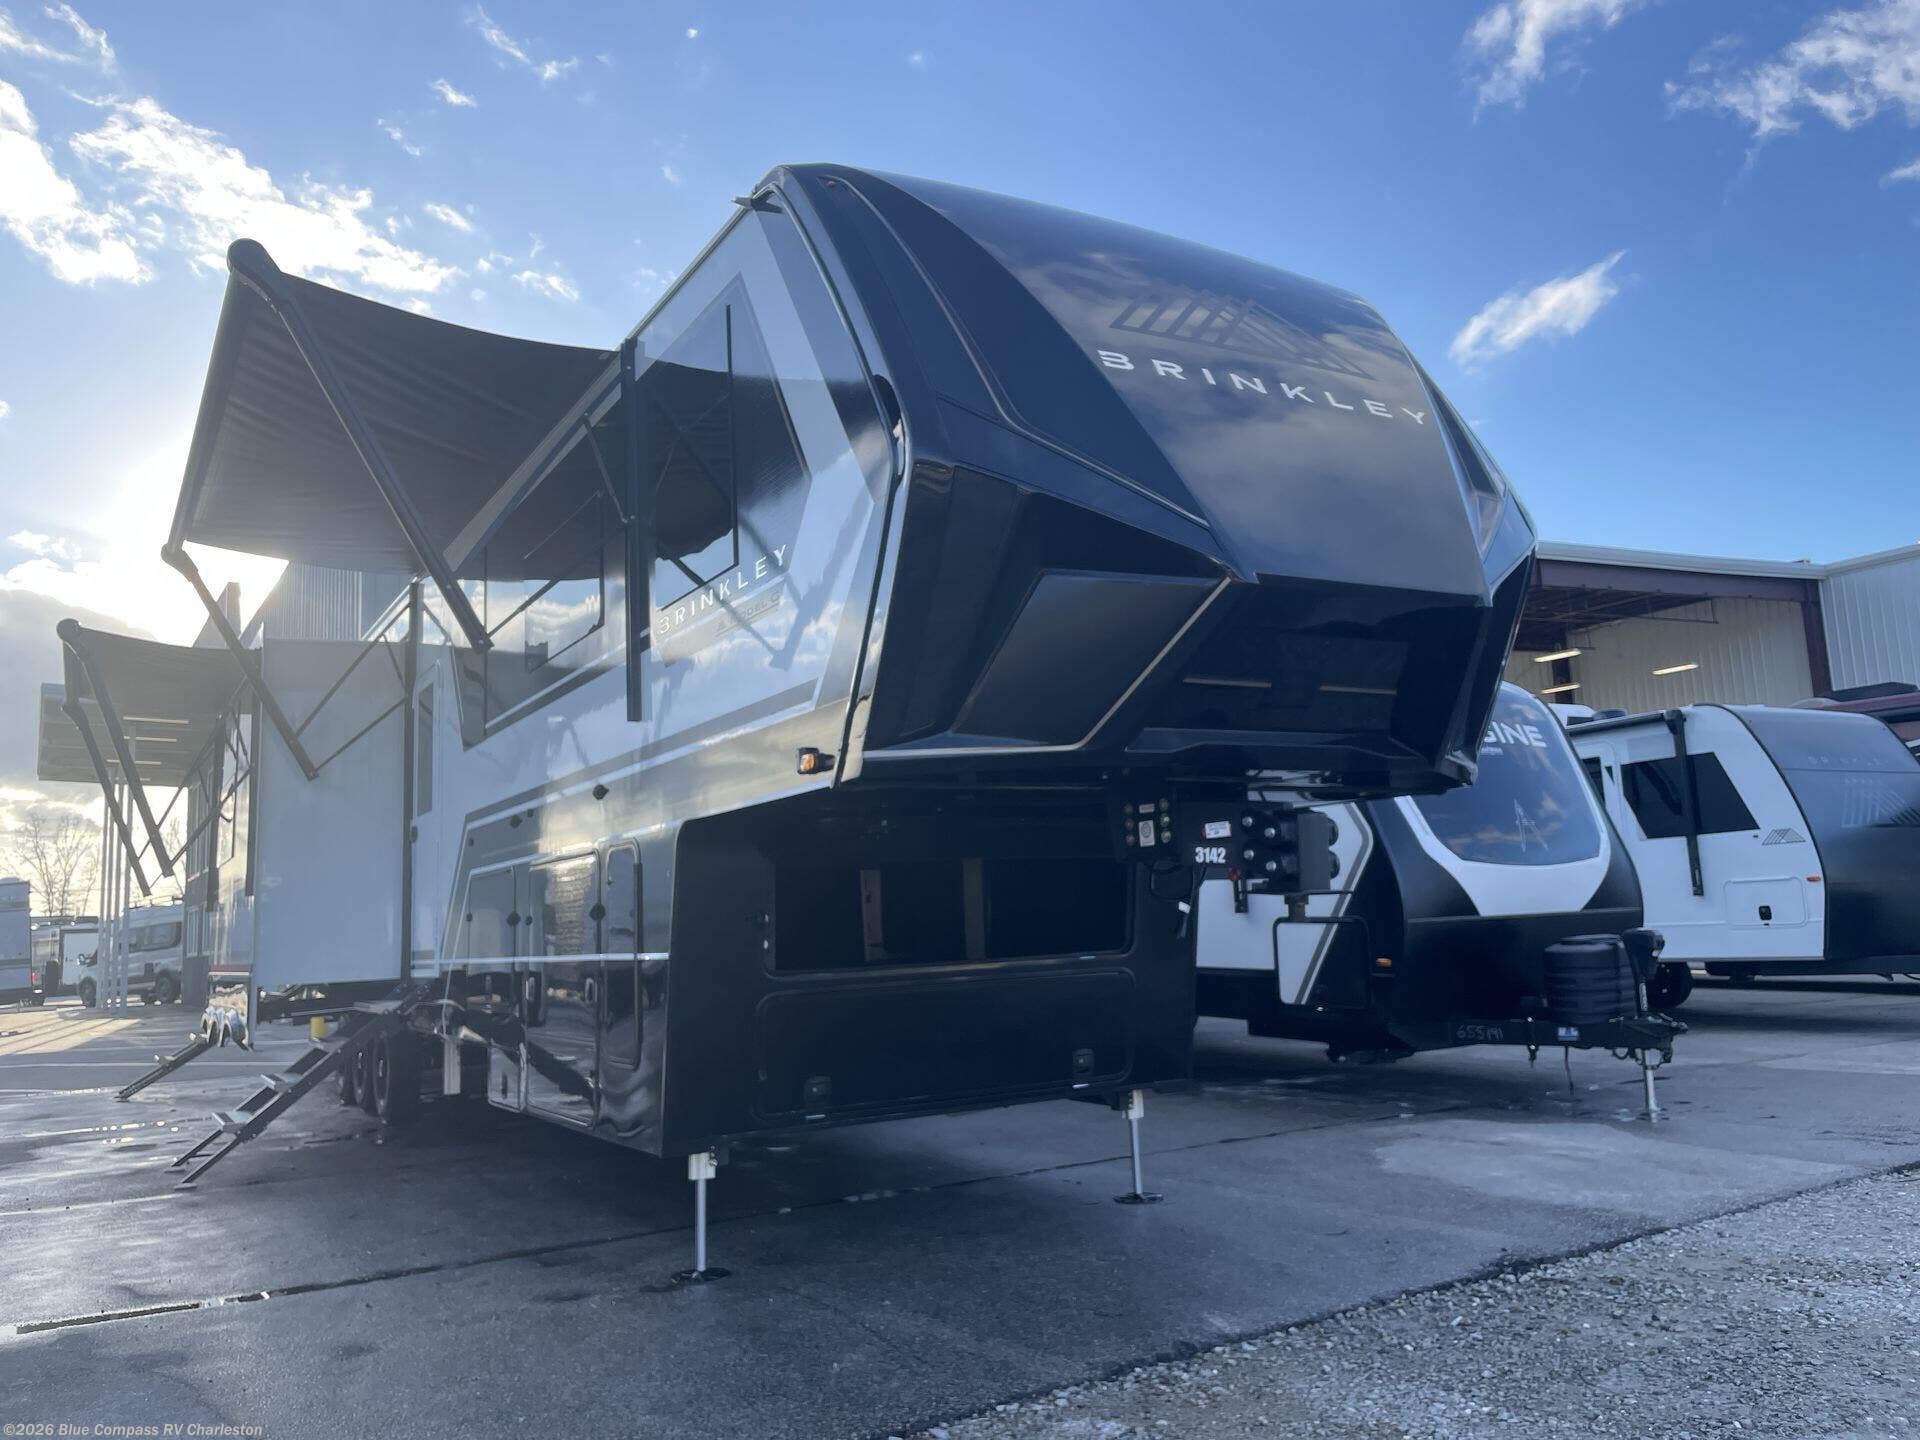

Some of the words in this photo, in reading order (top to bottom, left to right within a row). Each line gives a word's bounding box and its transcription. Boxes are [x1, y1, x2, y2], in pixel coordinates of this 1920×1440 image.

[1097, 349, 1425, 425] BRINKLEY
[660, 544, 787, 634] BRINKLEY
[1195, 846, 1226, 864] 3142
